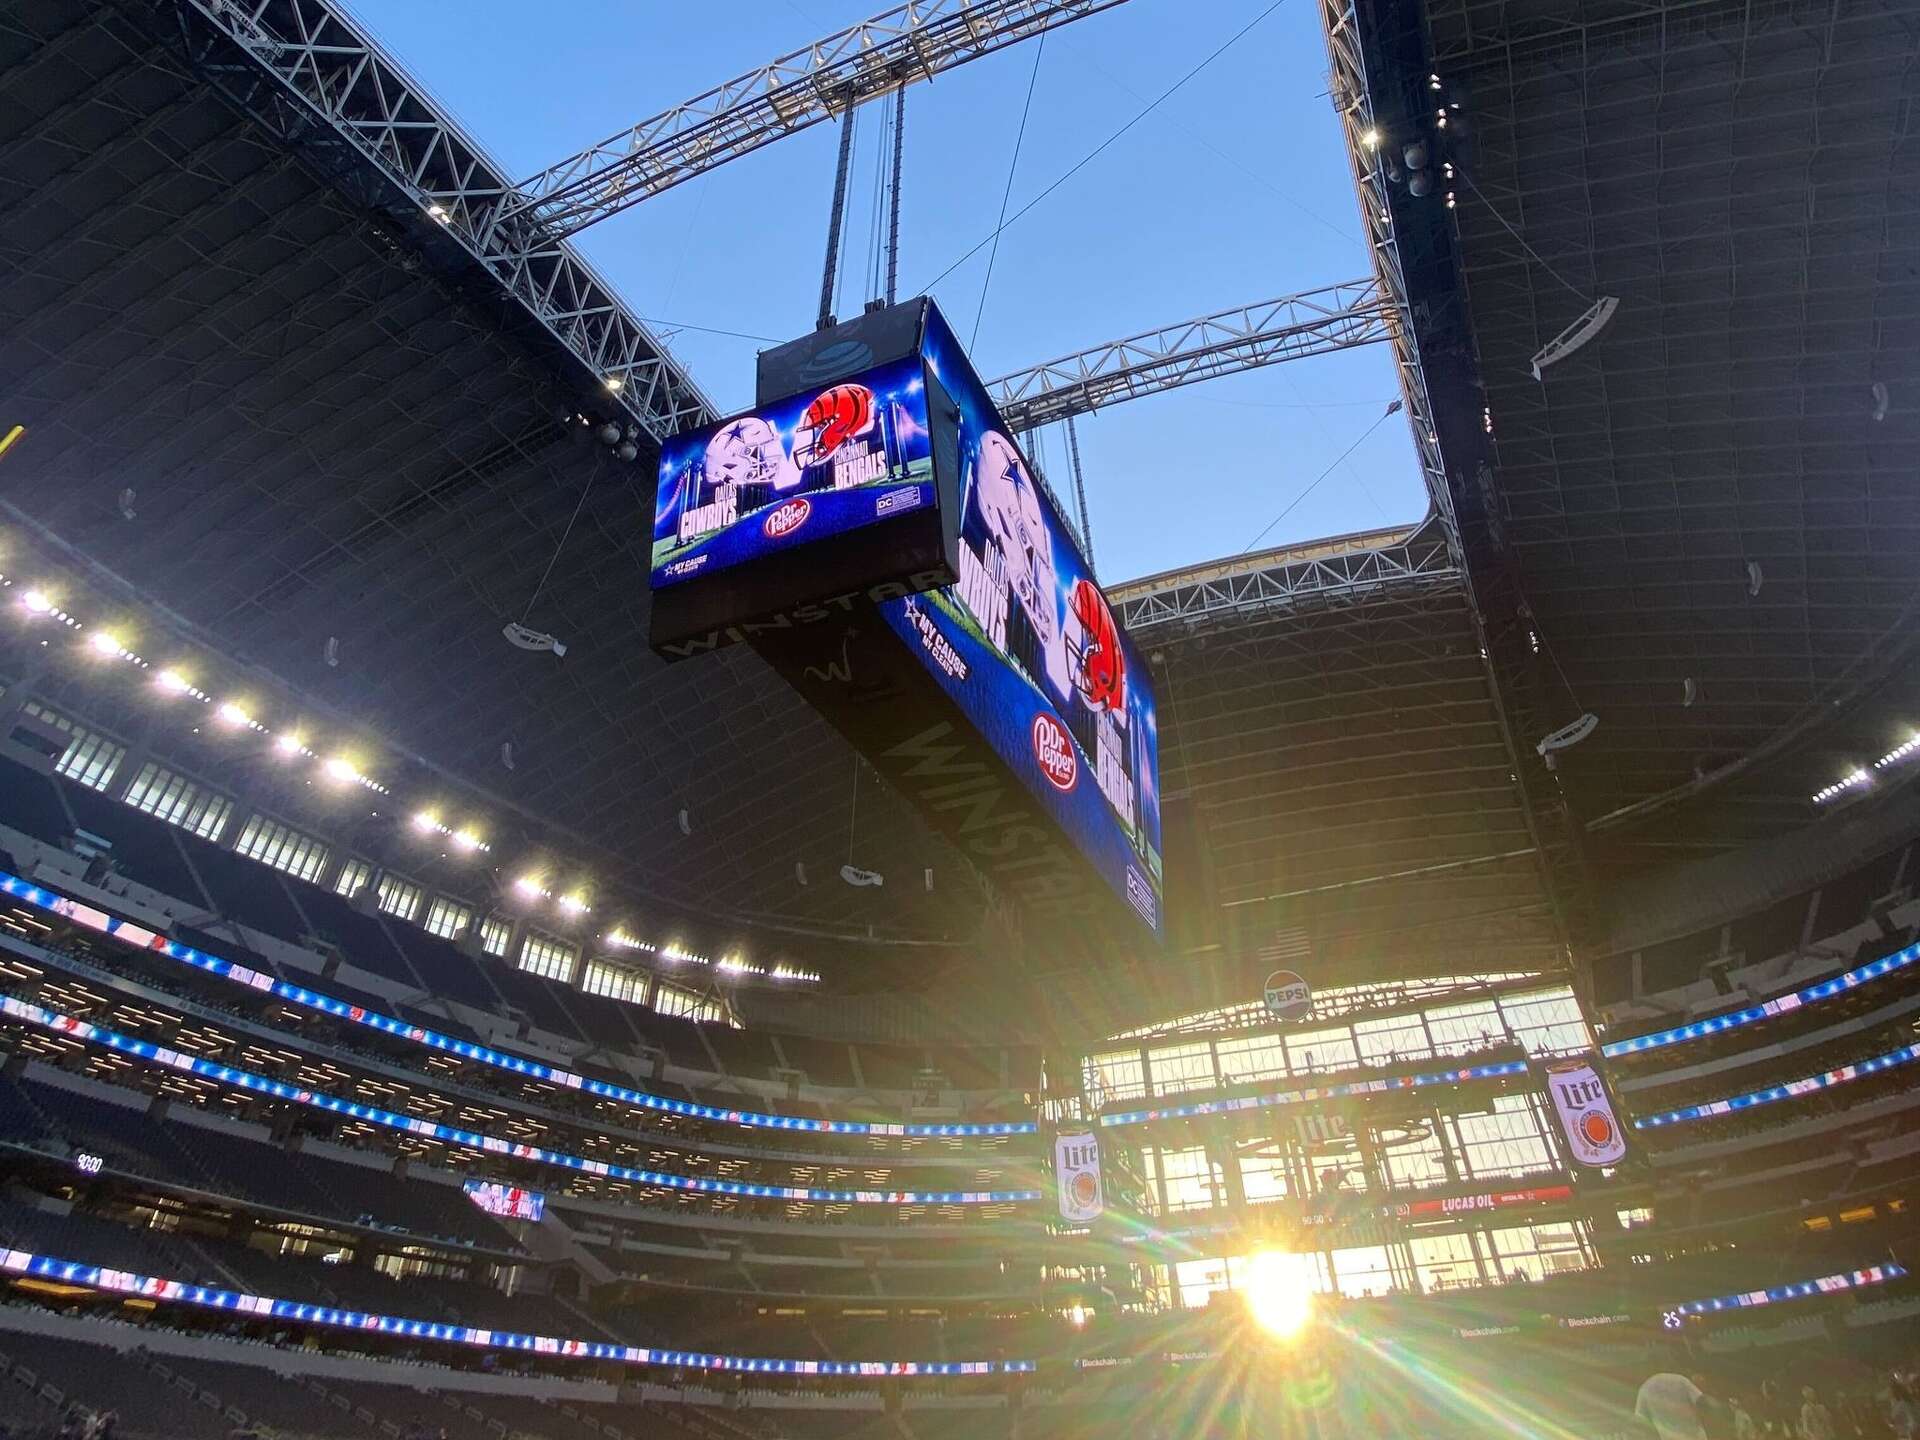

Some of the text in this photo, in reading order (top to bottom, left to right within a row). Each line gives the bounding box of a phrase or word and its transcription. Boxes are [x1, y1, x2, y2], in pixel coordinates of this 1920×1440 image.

[835, 450, 887, 490] BENGALS
[680, 499, 737, 540] COWBOYS
[768, 505, 807, 536] Pepper
[780, 503, 798, 519] Dr
[919, 613, 967, 680] MY CAUSE
[1035, 716, 1074, 777] Pepper
[1050, 722, 1065, 752] Dr
[1267, 987, 1309, 1004] PEPSI
[1558, 1080, 1603, 1111] Lite
[1293, 1114, 1348, 1148] Lite
[1063, 1144, 1098, 1172] Lite
[1442, 1196, 1475, 1211] LUCAS
[1477, 1194, 1495, 1208] OIL
